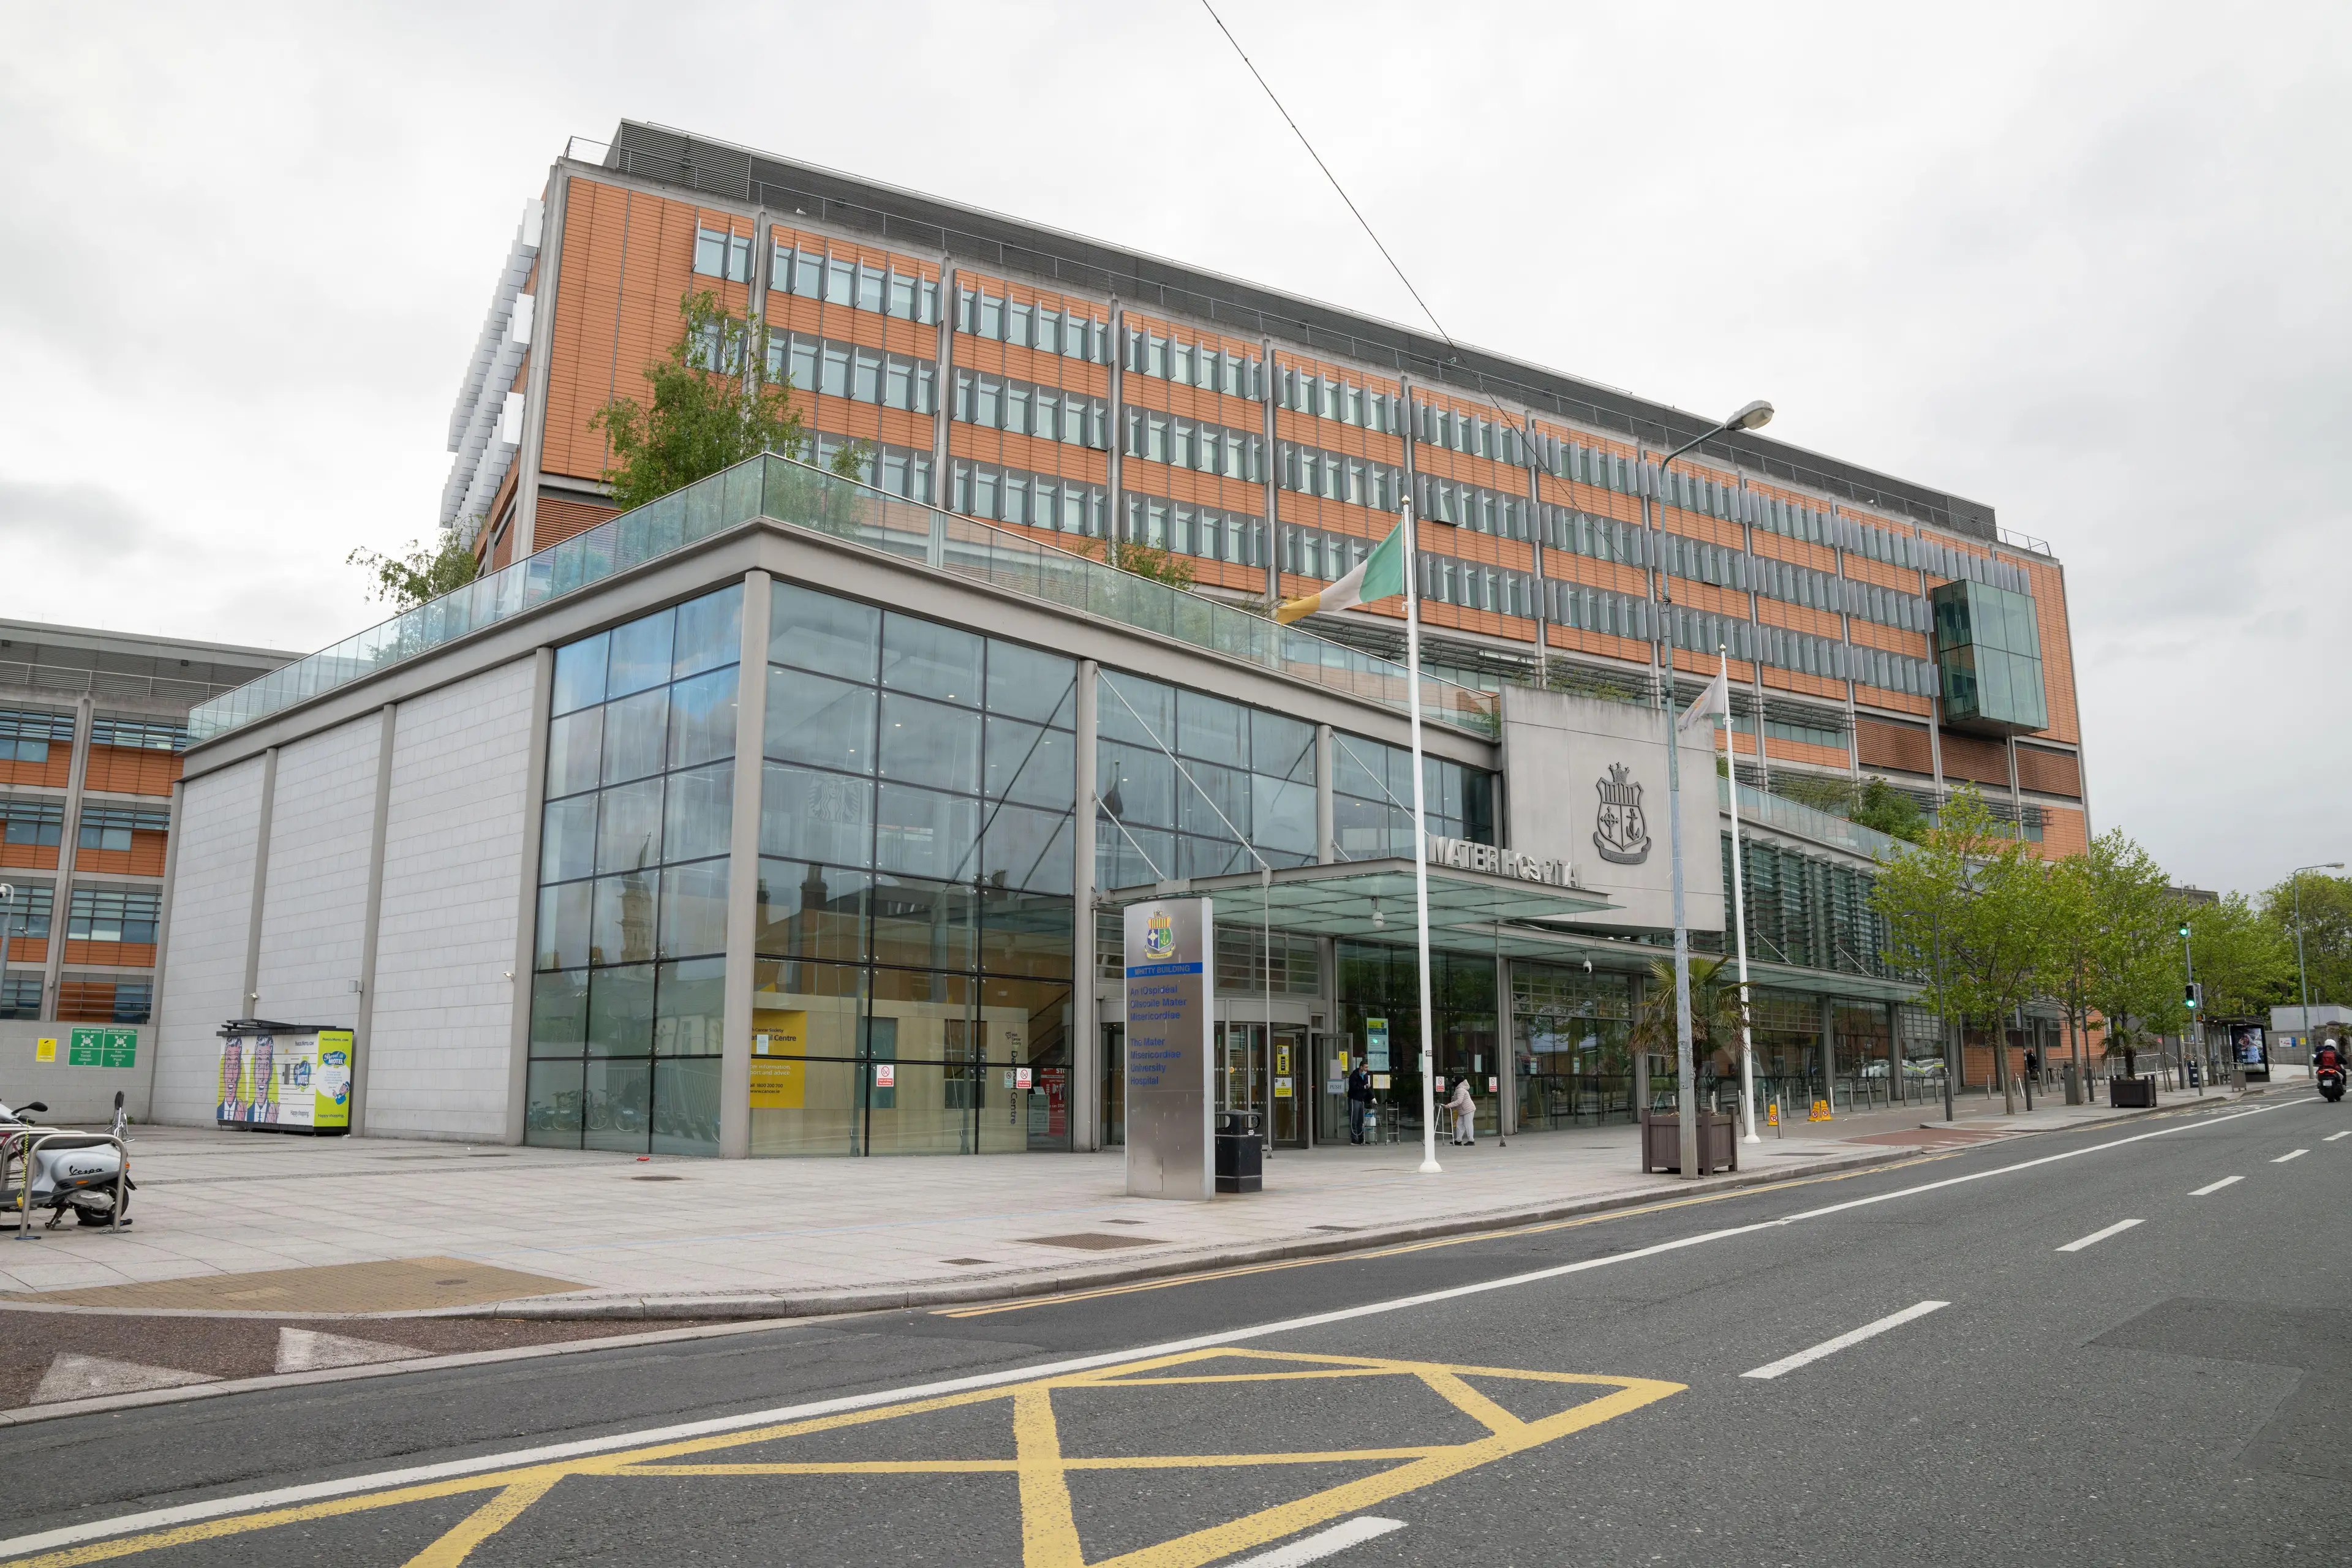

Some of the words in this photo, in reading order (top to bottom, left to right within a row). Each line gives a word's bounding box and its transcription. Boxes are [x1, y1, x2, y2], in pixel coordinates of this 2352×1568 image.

[1428, 834, 1499, 873] MATER
[1501, 849, 1583, 889] HOSPITAL
[1134, 967, 1155, 976] WHITTY
[1156, 965, 1190, 973] BUILDING
[1130, 1000, 1160, 1008] Ollscoile
[1162, 998, 1187, 1006] Mater
[1130, 1011, 1181, 1021] Misericordiae
[1130, 1038, 1142, 1047] The
[1144, 1037, 1165, 1046] Mater
[1130, 1049, 1181, 1060] Misericordiae
[1130, 1063, 1166, 1073] University
[297, 1074, 309, 1084] MOTEL
[1130, 1076, 1159, 1087] Hospital
[69, 1165, 105, 1176] Vespa
